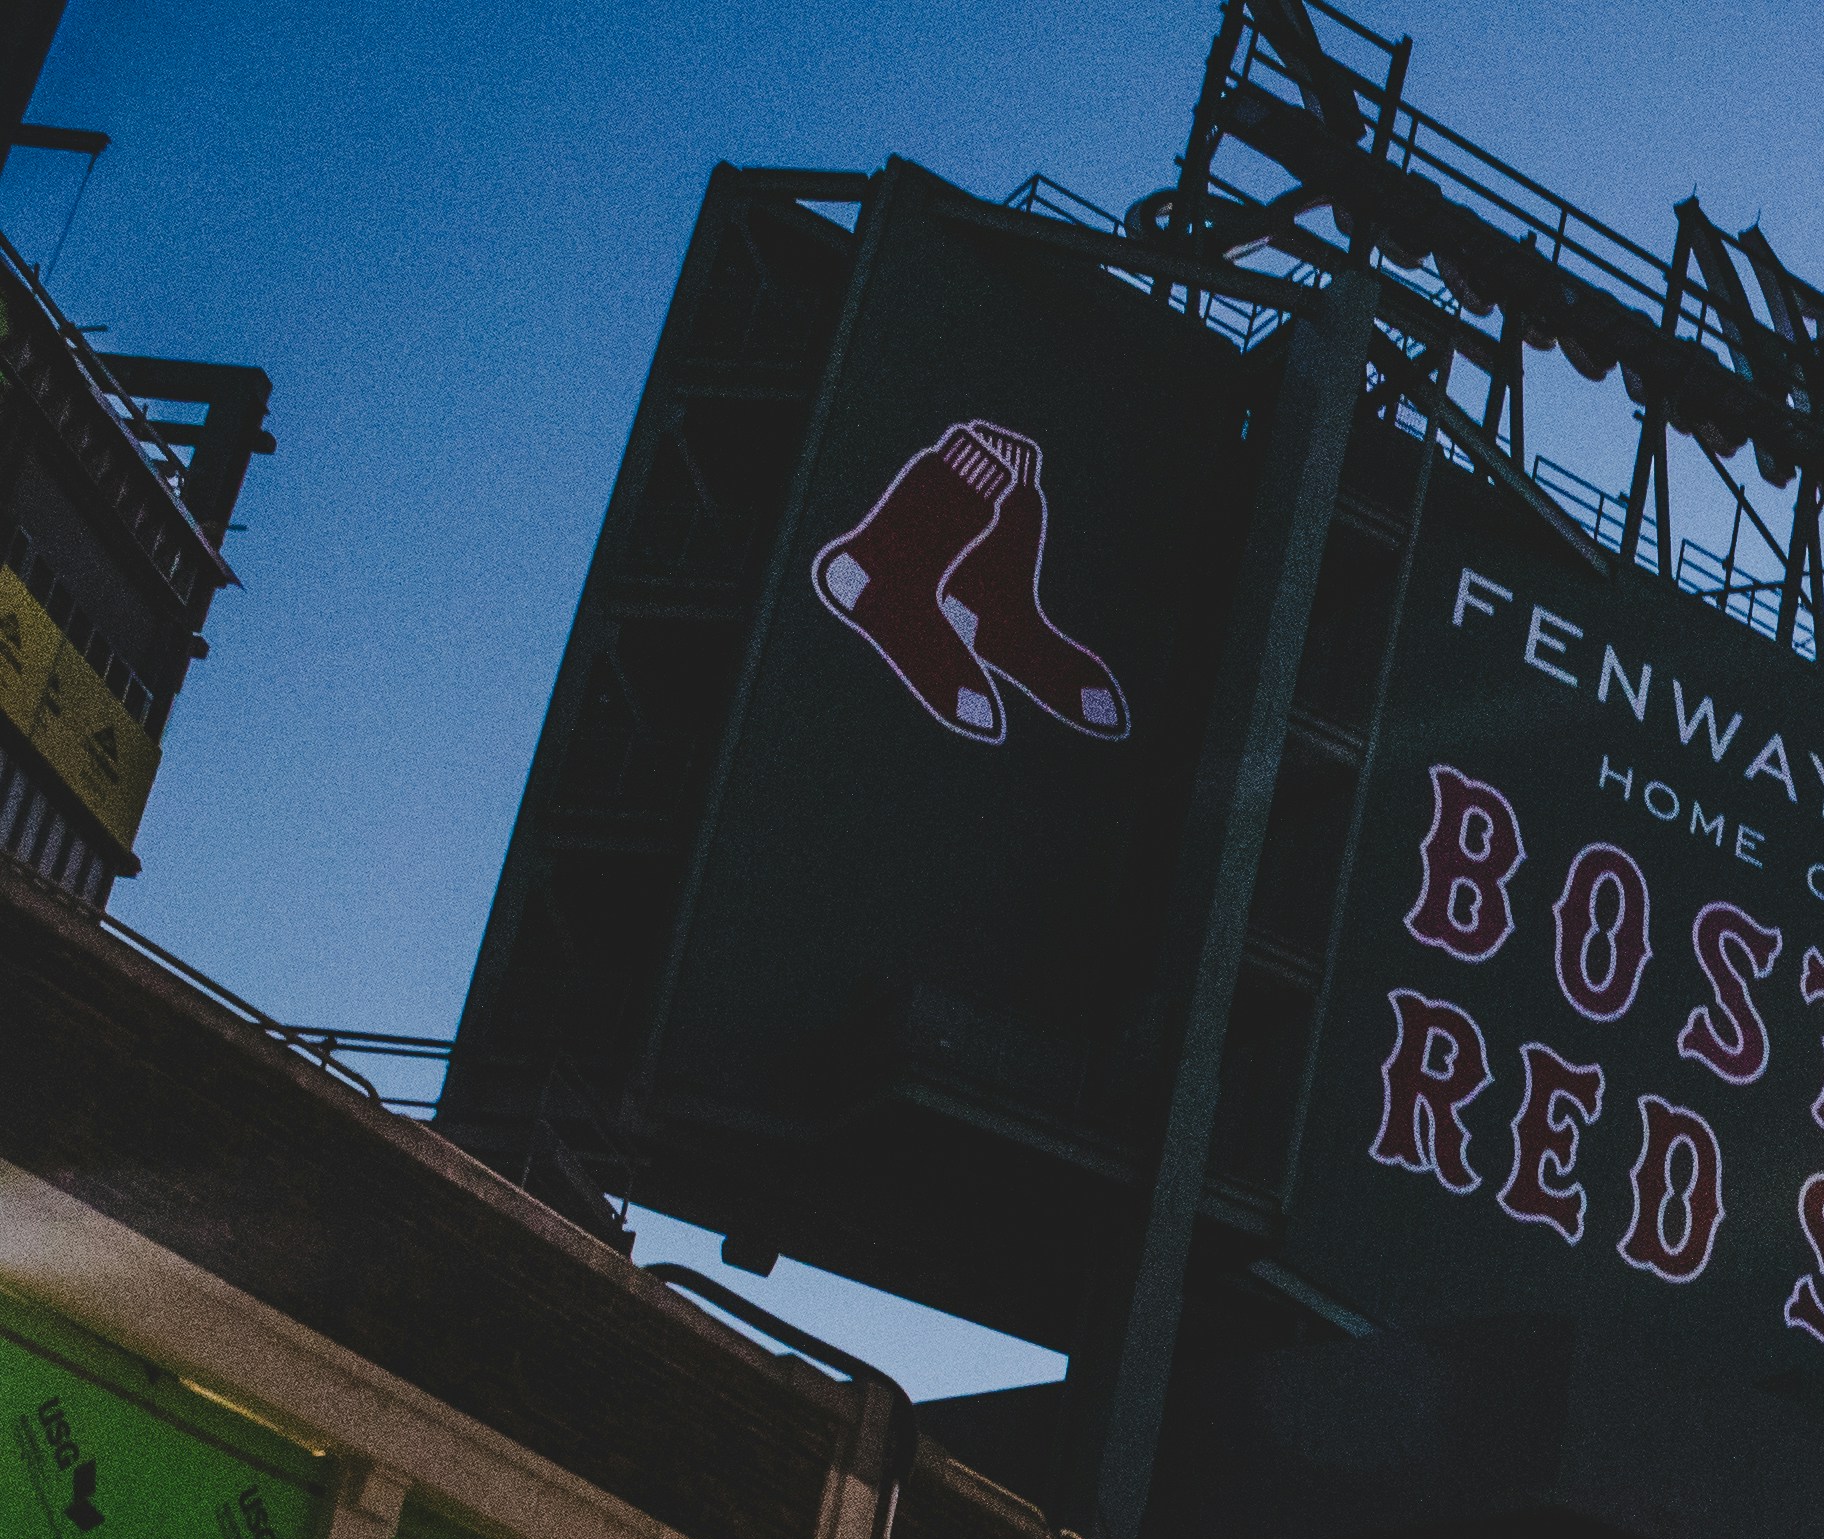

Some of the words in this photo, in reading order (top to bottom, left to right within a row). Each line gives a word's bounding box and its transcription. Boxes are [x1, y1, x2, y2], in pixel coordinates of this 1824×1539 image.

[1599, 753, 1766, 870] HOME
[1368, 988, 1726, 1284] RED
[37, 1396, 80, 1471] USG
